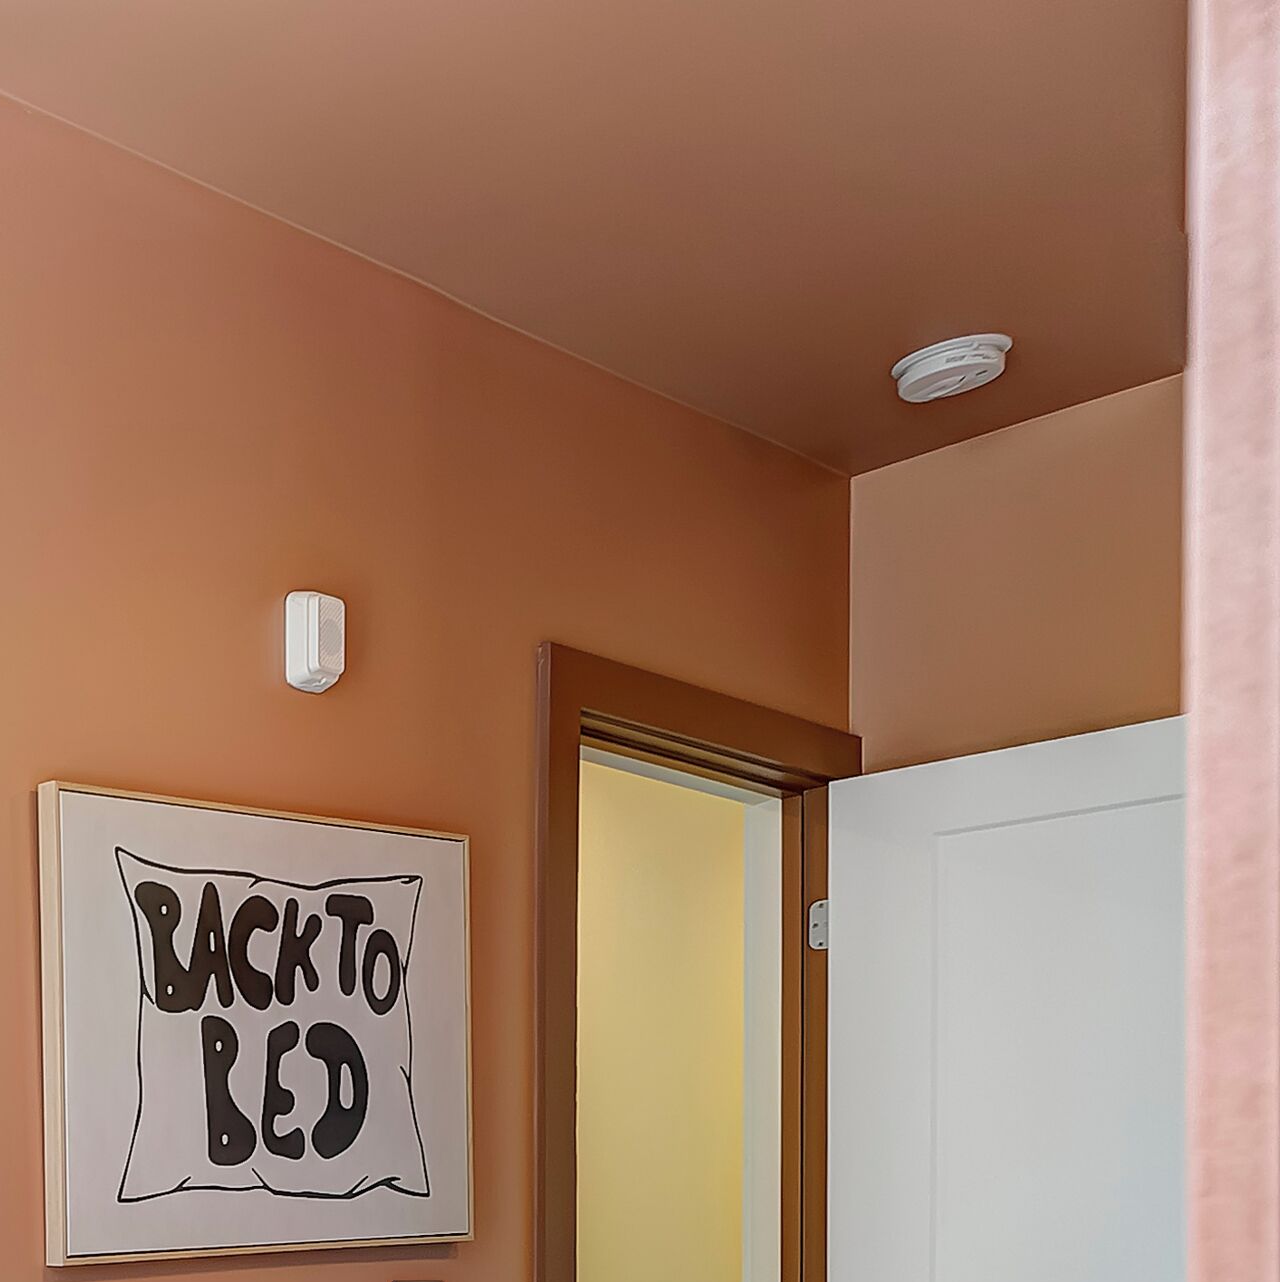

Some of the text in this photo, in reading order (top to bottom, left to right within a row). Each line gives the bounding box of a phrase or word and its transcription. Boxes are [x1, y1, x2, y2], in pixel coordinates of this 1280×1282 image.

[134, 881, 400, 1015] BACK TO
[201, 1015, 369, 1166] BED
